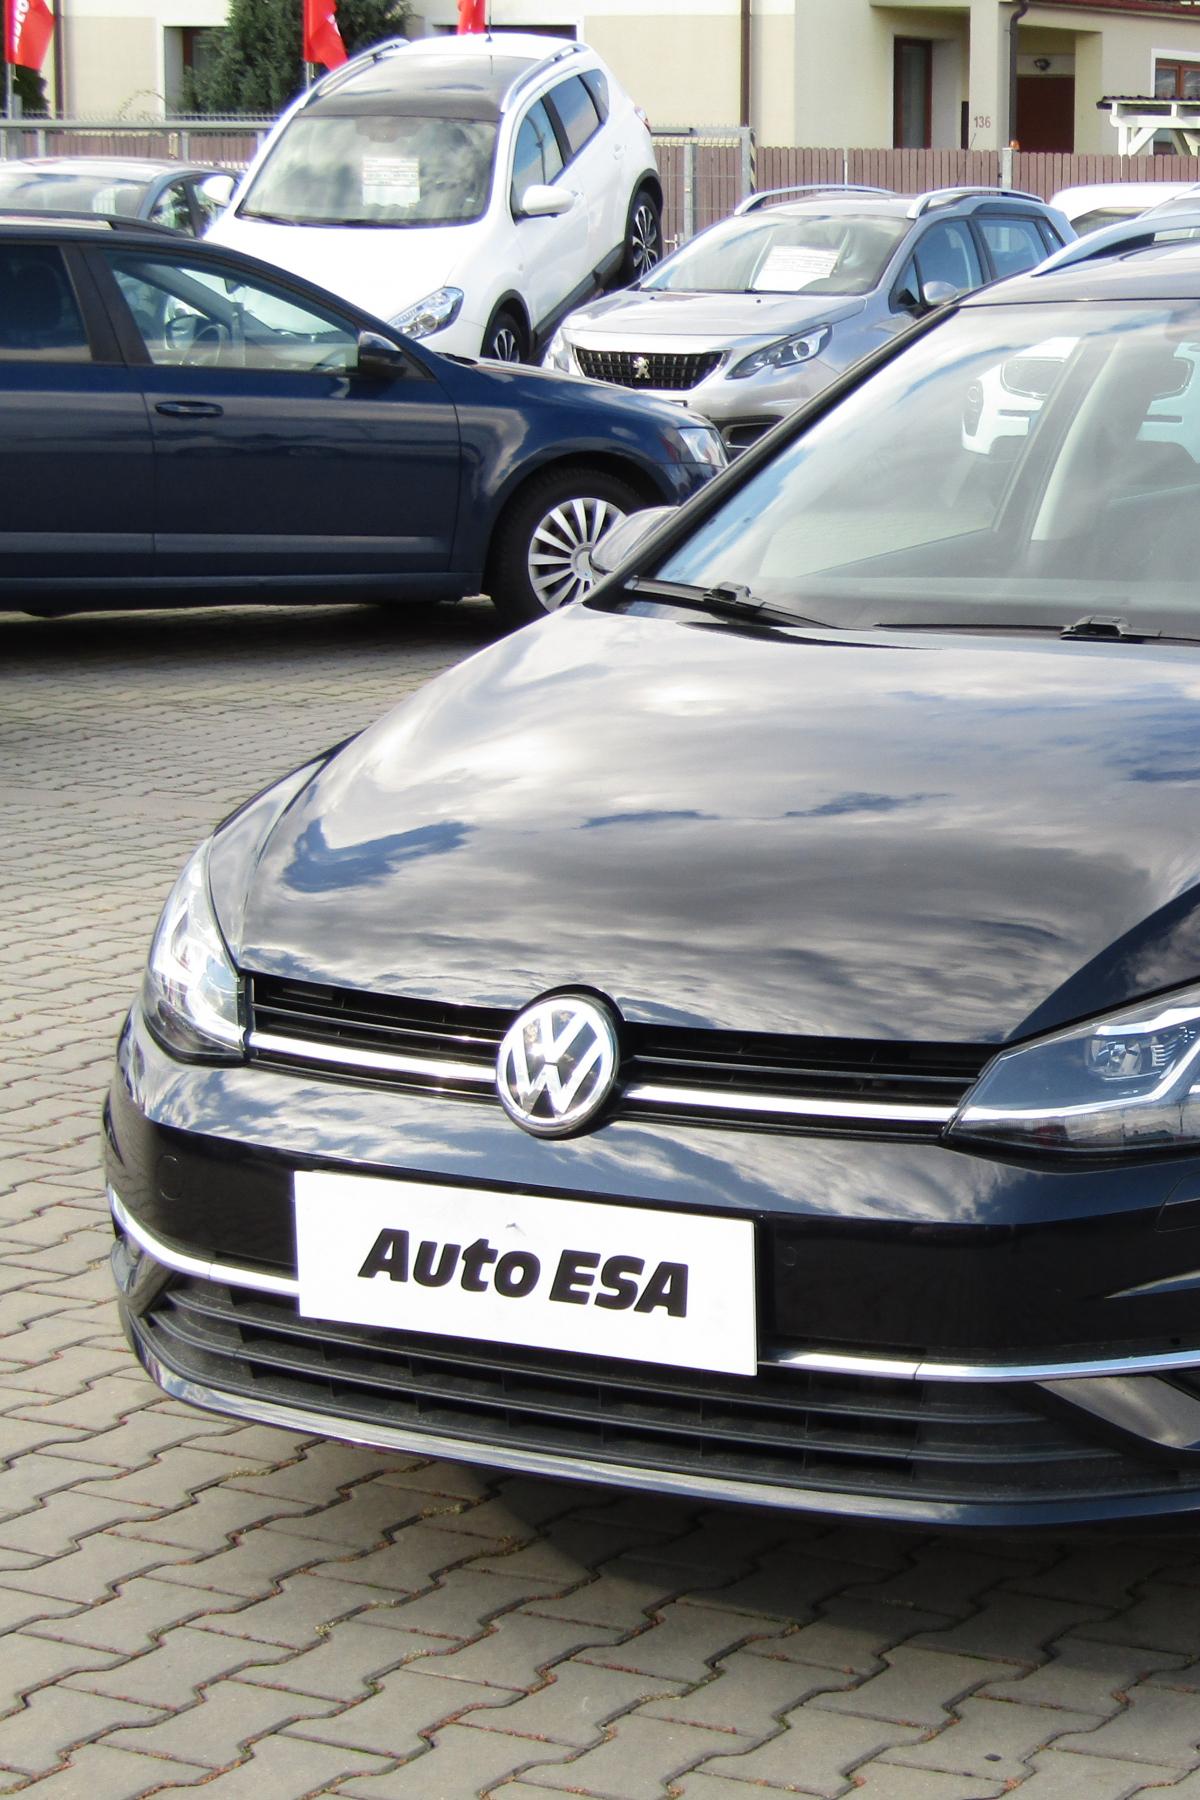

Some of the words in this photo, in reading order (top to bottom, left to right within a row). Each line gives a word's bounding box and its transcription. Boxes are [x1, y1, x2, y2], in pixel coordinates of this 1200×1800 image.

[974, 115, 991, 128] 136
[357, 1227, 541, 1298] Auto
[548, 1249, 689, 1318] ESA
